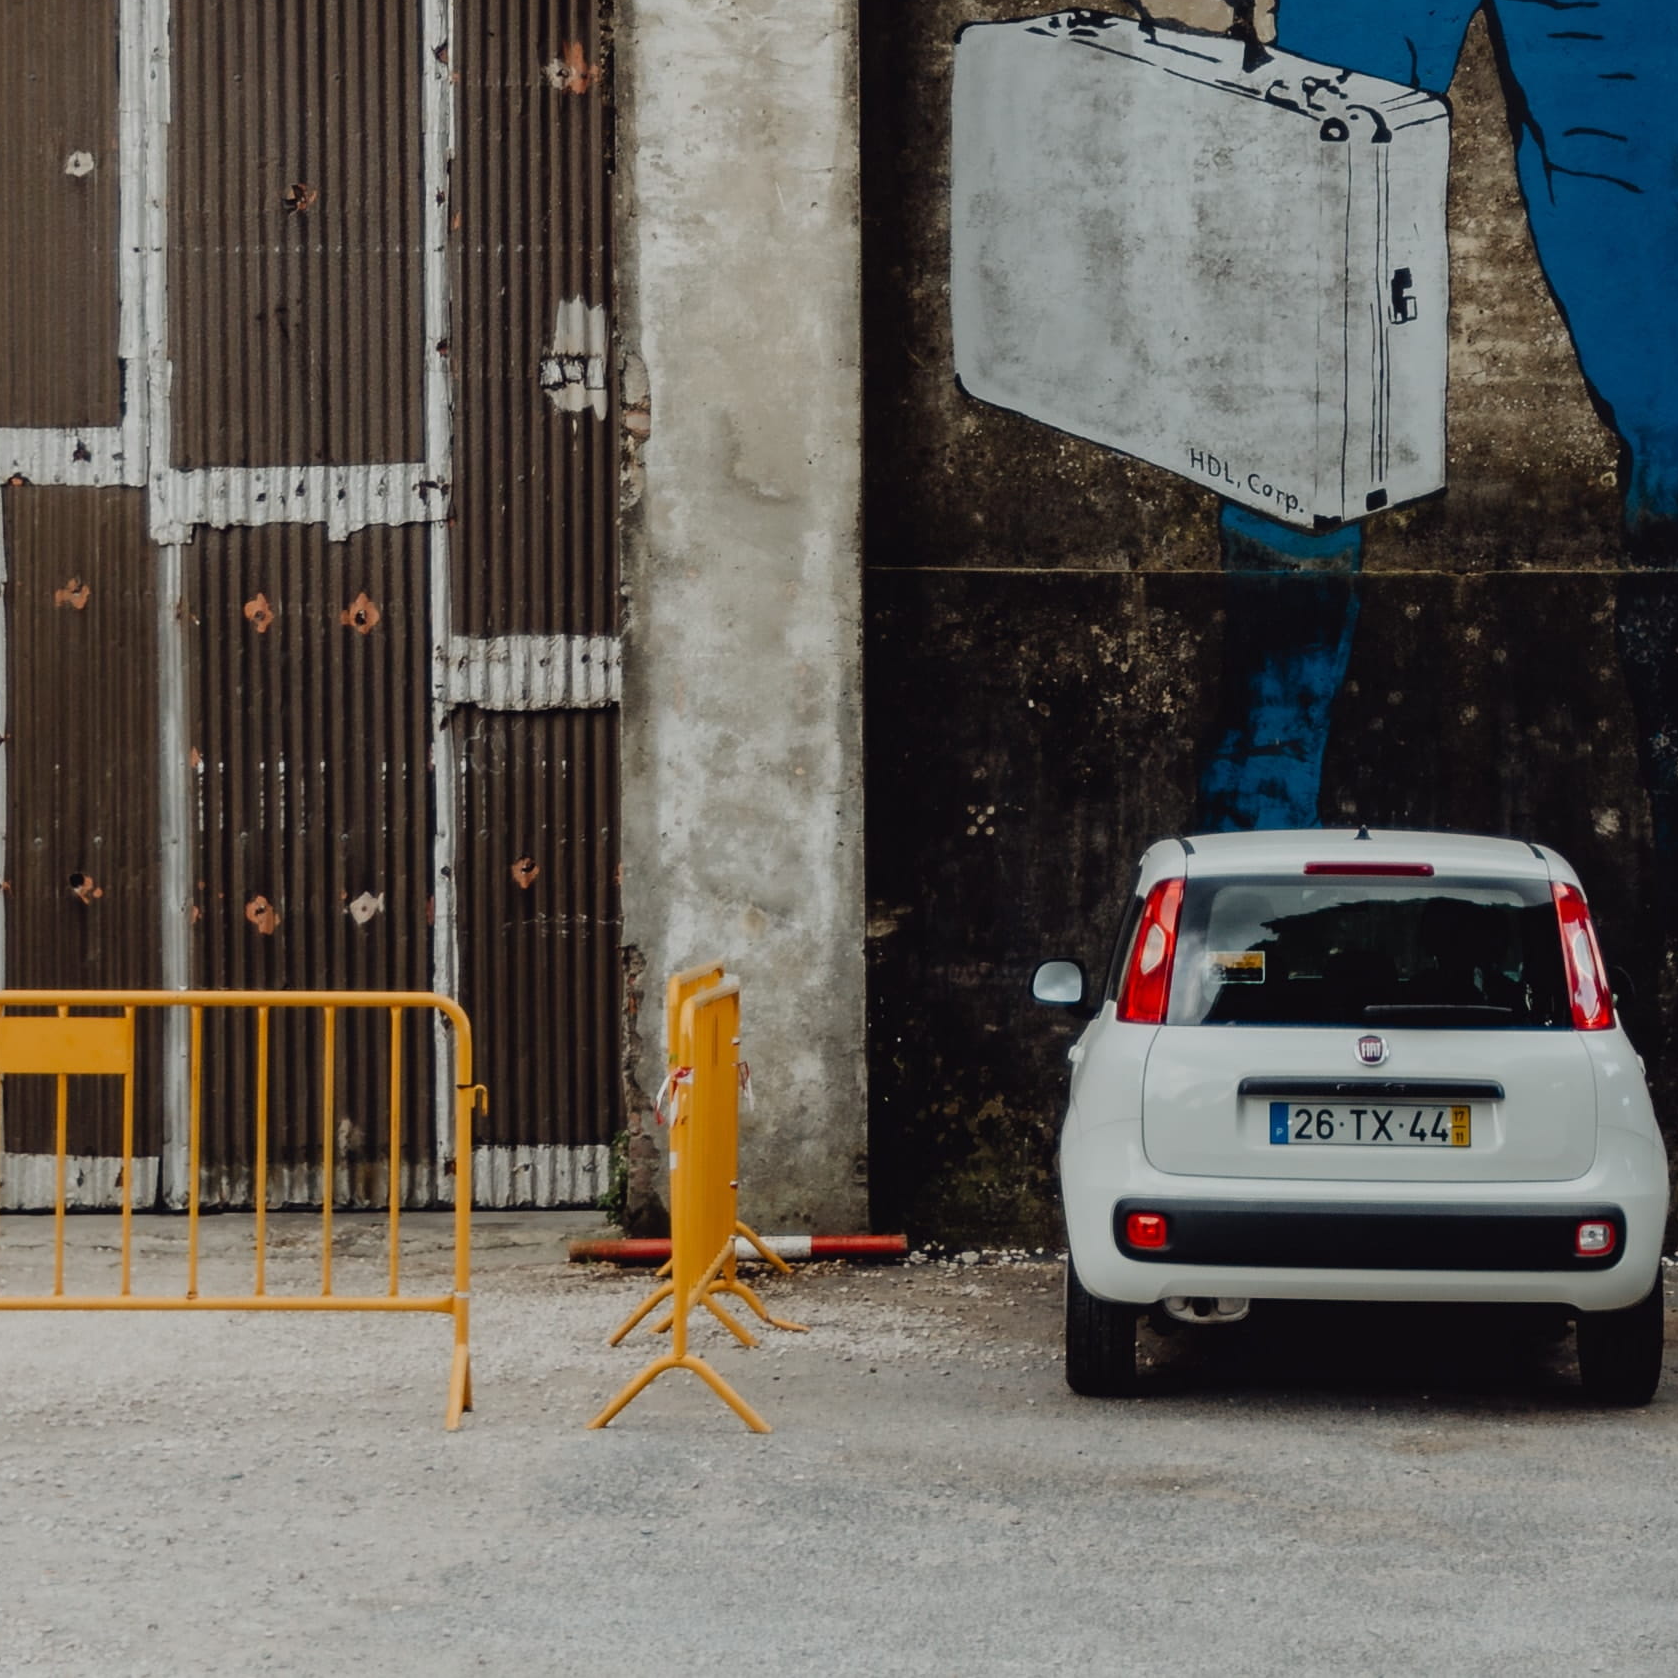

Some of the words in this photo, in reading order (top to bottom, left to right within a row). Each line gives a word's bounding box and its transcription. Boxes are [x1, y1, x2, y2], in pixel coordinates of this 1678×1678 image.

[1190, 447, 1240, 490] HDL,
[1247, 473, 1304, 514] Corp.
[1361, 1041, 1382, 1058] FIAT
[1453, 1110, 1465, 1123] 17
[1275, 1127, 1284, 1137] P
[1455, 1131, 1465, 1143] 11
